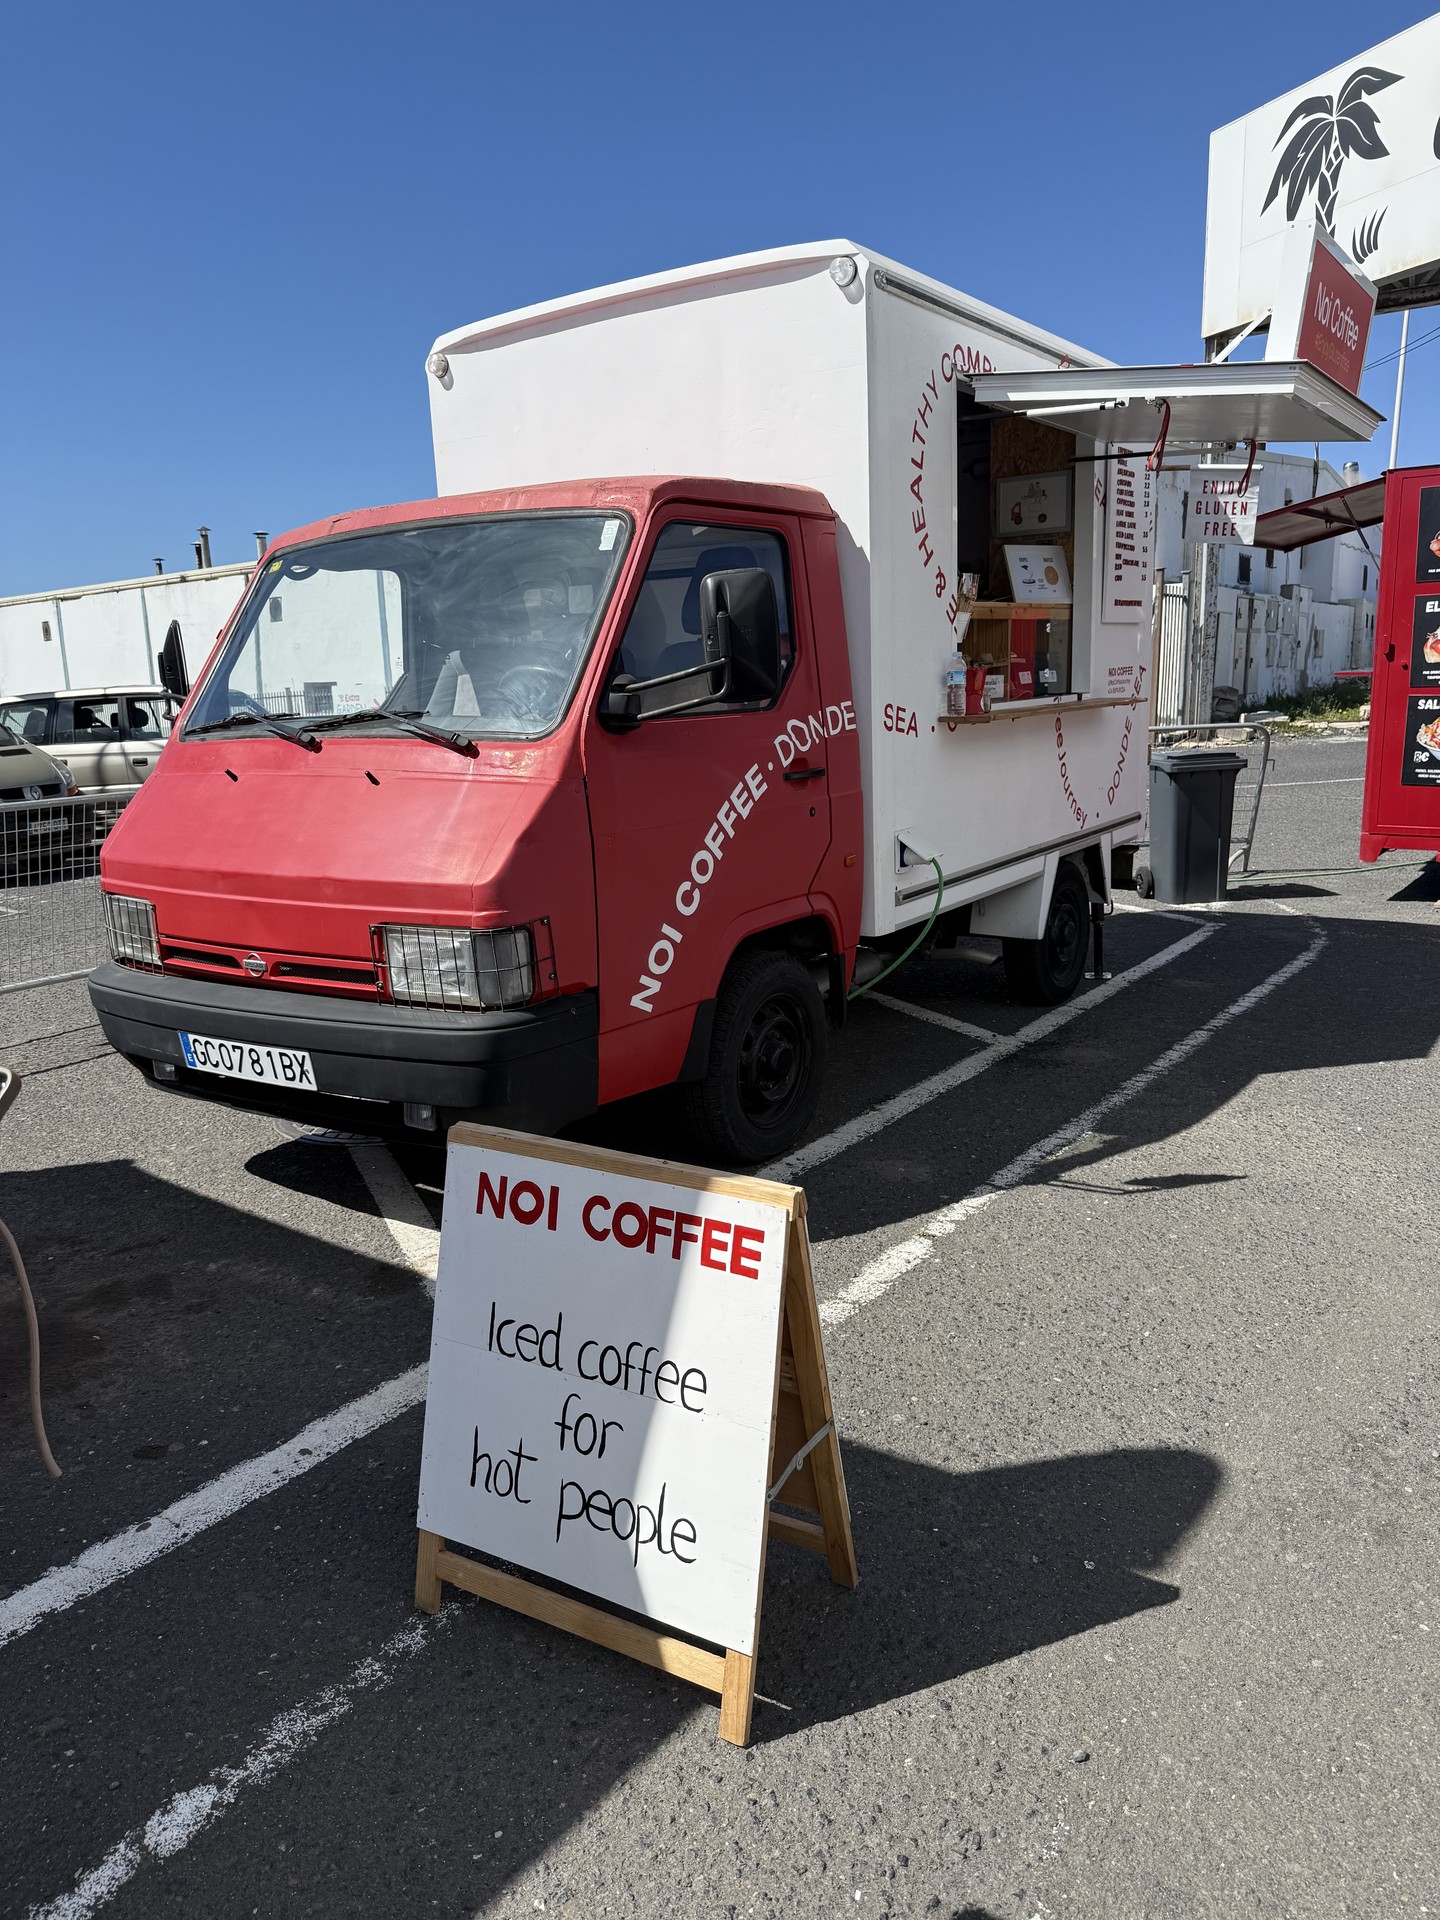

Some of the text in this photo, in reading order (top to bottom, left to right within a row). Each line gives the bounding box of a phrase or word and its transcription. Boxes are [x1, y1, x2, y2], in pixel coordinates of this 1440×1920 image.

[1314, 281, 1359, 351] Noi Coffee
[910, 370, 939, 568] HEALTHY
[1195, 500, 1248, 515] GLUTEN
[1204, 521, 1237, 536] FREE
[935, 565, 947, 598] &
[1117, 666, 1133, 677] COFFEE
[1058, 751, 1088, 829] Journey
[1107, 716, 1132, 805] DONDE
[629, 701, 919, 1013] NOI COFFEE DONDE SEA
[475, 1171, 765, 1280] NOI COFFEE
[488, 1301, 708, 1413] Iced coffee
[470, 1425, 539, 1504] hot
[554, 1393, 624, 1459] for
[556, 1478, 697, 1568] people
